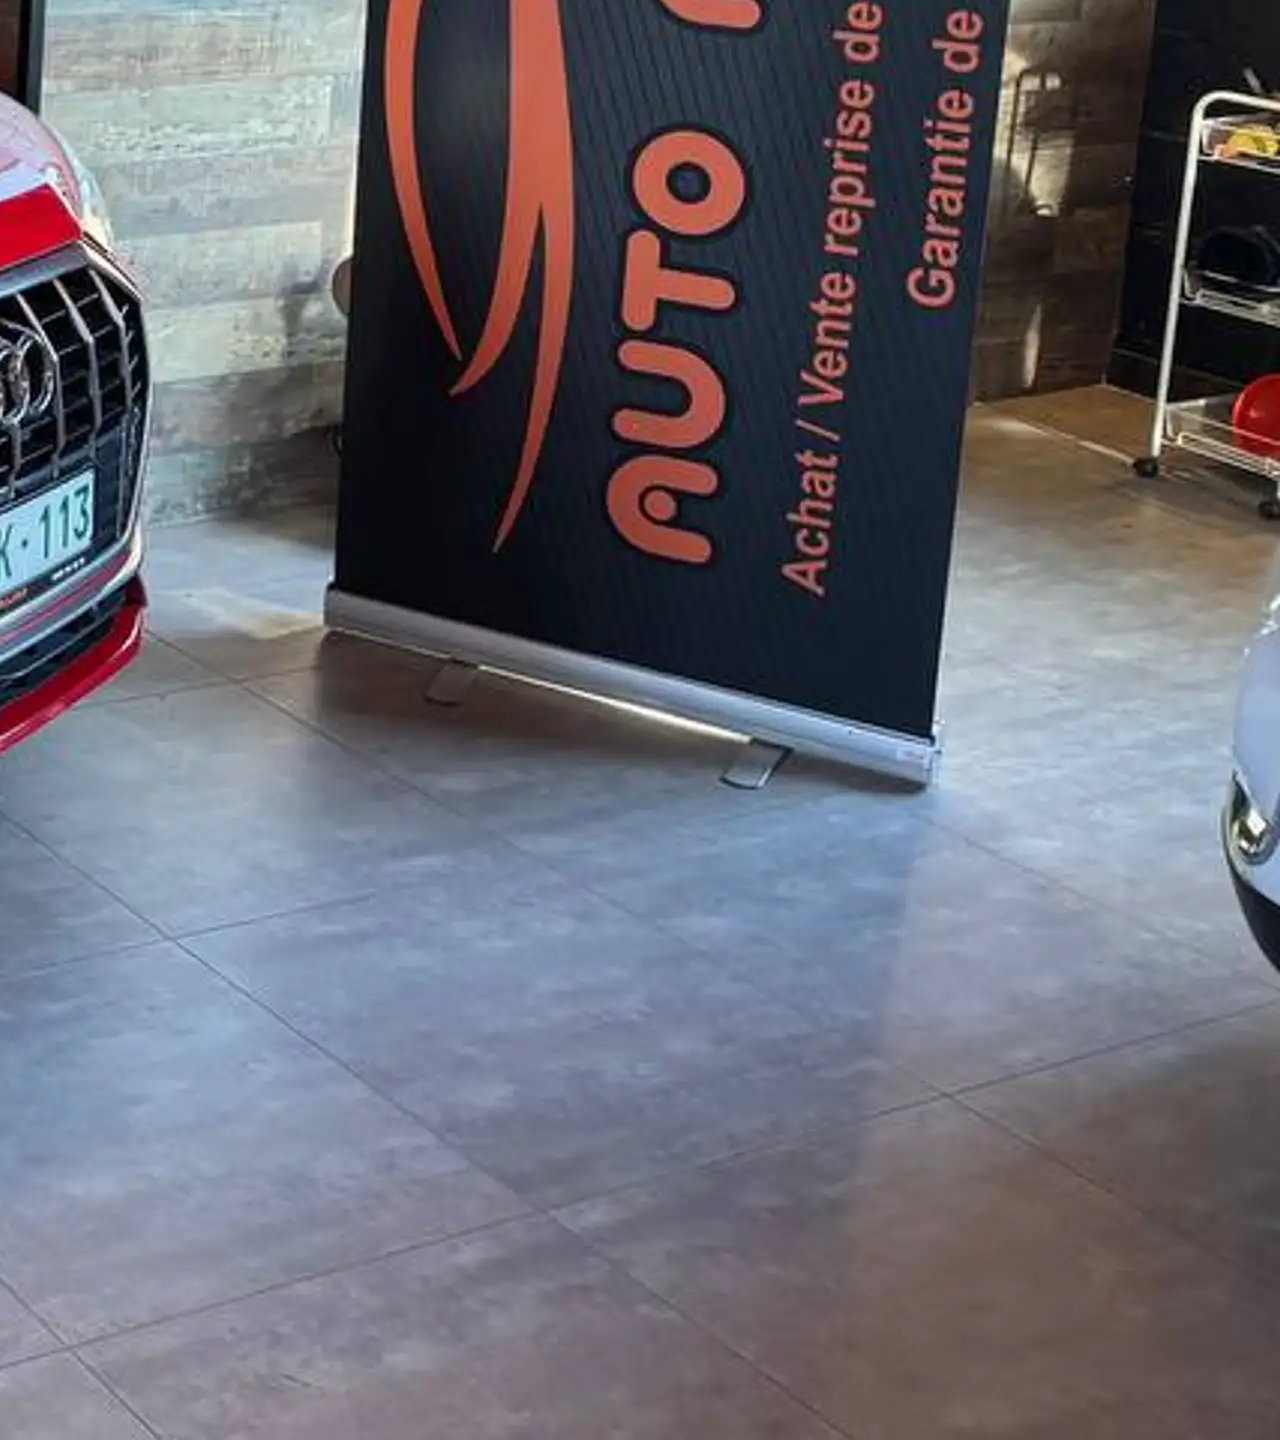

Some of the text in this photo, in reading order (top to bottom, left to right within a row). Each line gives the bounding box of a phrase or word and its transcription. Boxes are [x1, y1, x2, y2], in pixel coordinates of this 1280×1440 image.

[832, 0, 884, 65] de
[931, 7, 984, 74] de
[823, 79, 876, 257] reprise
[906, 89, 975, 309] Garantie
[606, 130, 746, 564] AUTO
[796, 269, 858, 407] Vente
[794, 417, 841, 443] /
[781, 449, 839, 598] Achat
